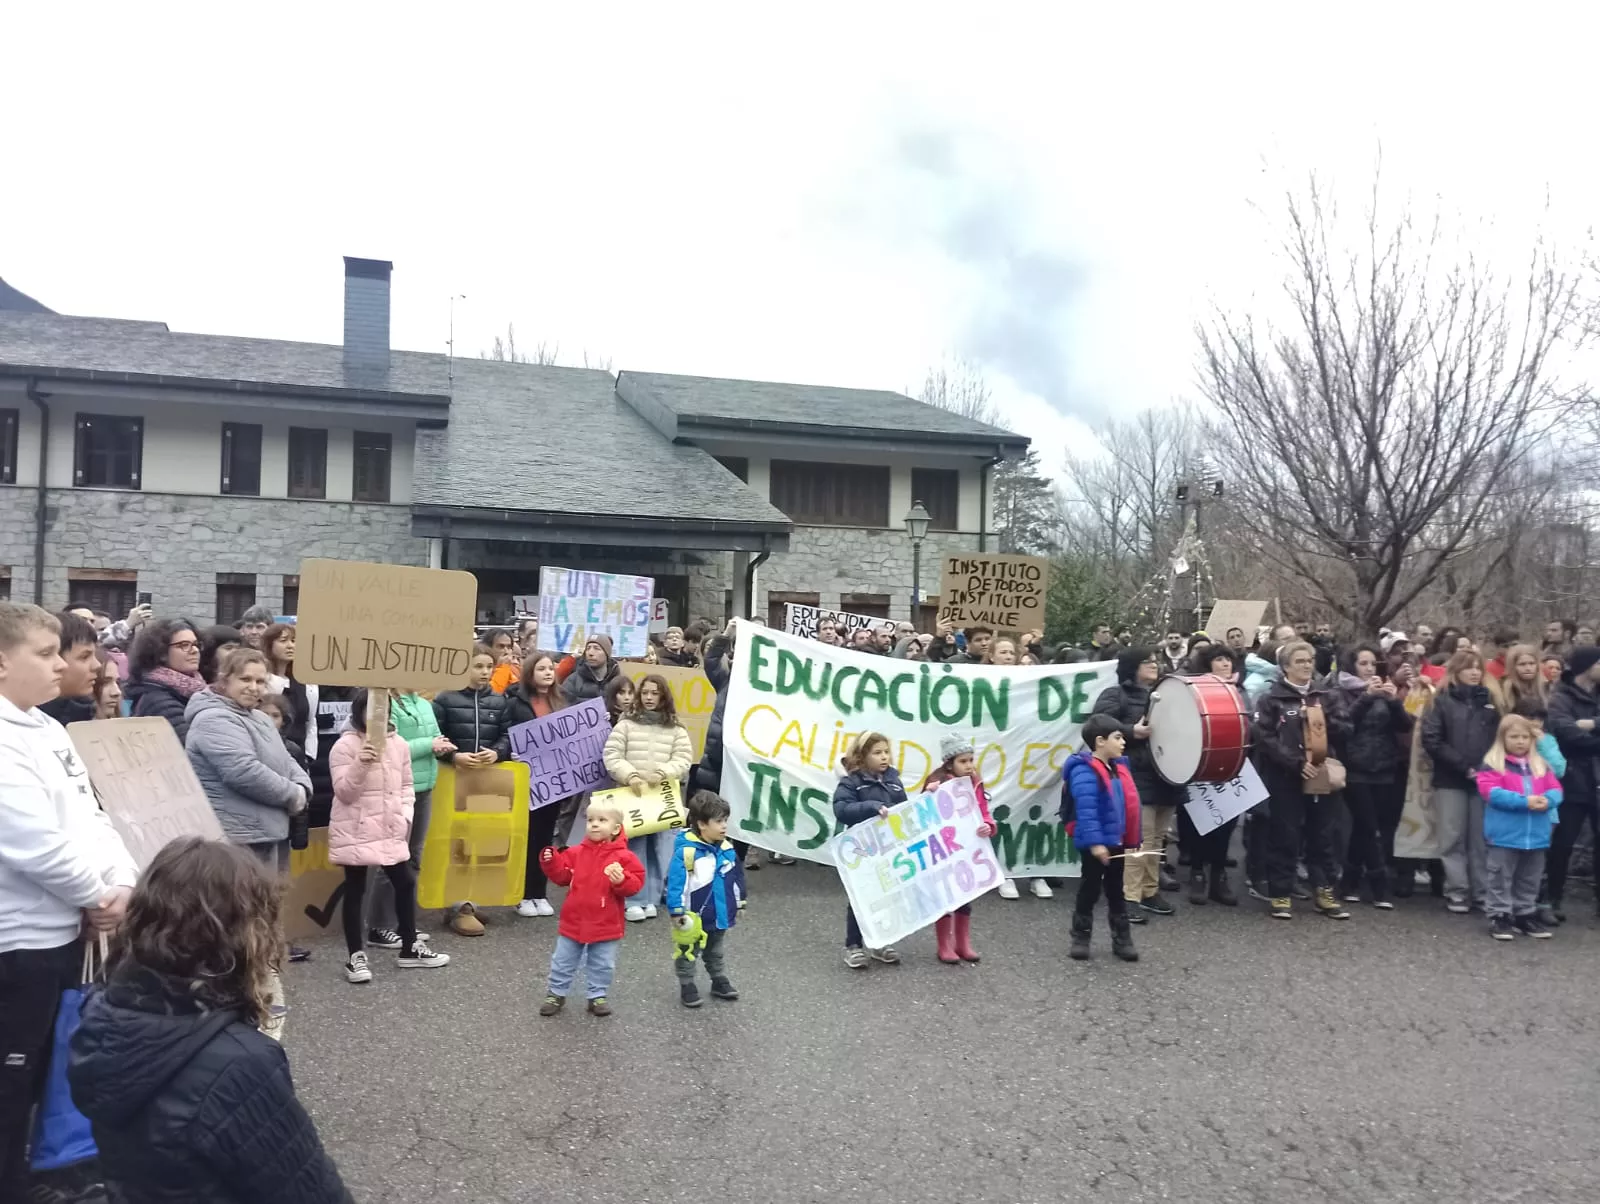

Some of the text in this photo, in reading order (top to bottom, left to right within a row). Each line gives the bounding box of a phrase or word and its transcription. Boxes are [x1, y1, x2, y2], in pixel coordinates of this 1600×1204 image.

[315, 569, 424, 598] UN VALLE
[949, 558, 1041, 581] INSTITUTO
[967, 576, 991, 592] DE
[949, 589, 1038, 609] INSTITUTO
[941, 606, 1021, 627] DEL VALLE
[310, 634, 471, 676] UN INSTITUTO
[1038, 671, 1099, 725] DE
[513, 707, 599, 755] LA UNIDAD
[529, 781, 550, 806] NO
[551, 772, 572, 796] SE
[629, 809, 644, 828] UN
[838, 783, 976, 870] QUEREMOS
[875, 826, 964, 894] ESTAR
